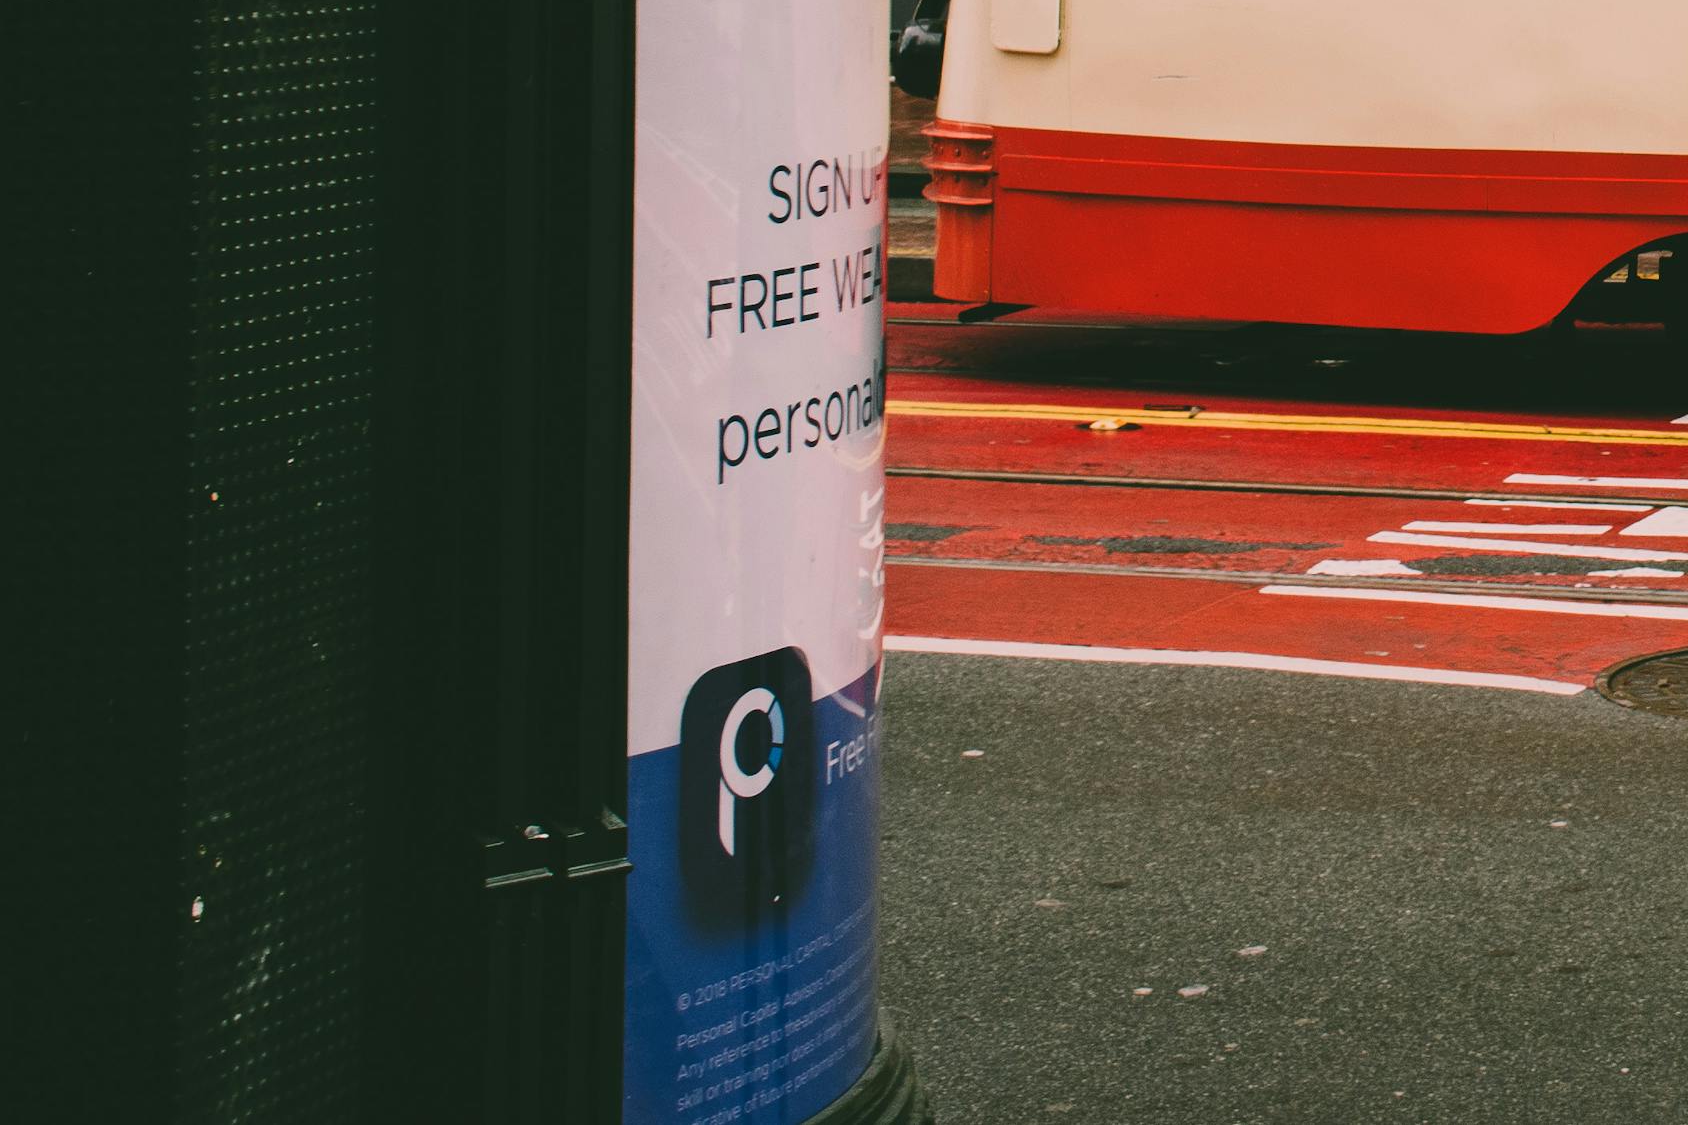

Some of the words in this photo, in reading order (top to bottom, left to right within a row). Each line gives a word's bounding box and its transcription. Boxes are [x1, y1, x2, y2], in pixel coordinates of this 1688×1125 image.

[768, 154, 851, 224] SIGN
[706, 262, 820, 339] FREE
[826, 734, 866, 786] Free
[694, 979, 728, 1006] 2018
[676, 1016, 737, 1051] Personal
[677, 1060, 707, 1082] Any
[708, 1034, 770, 1069] reference
